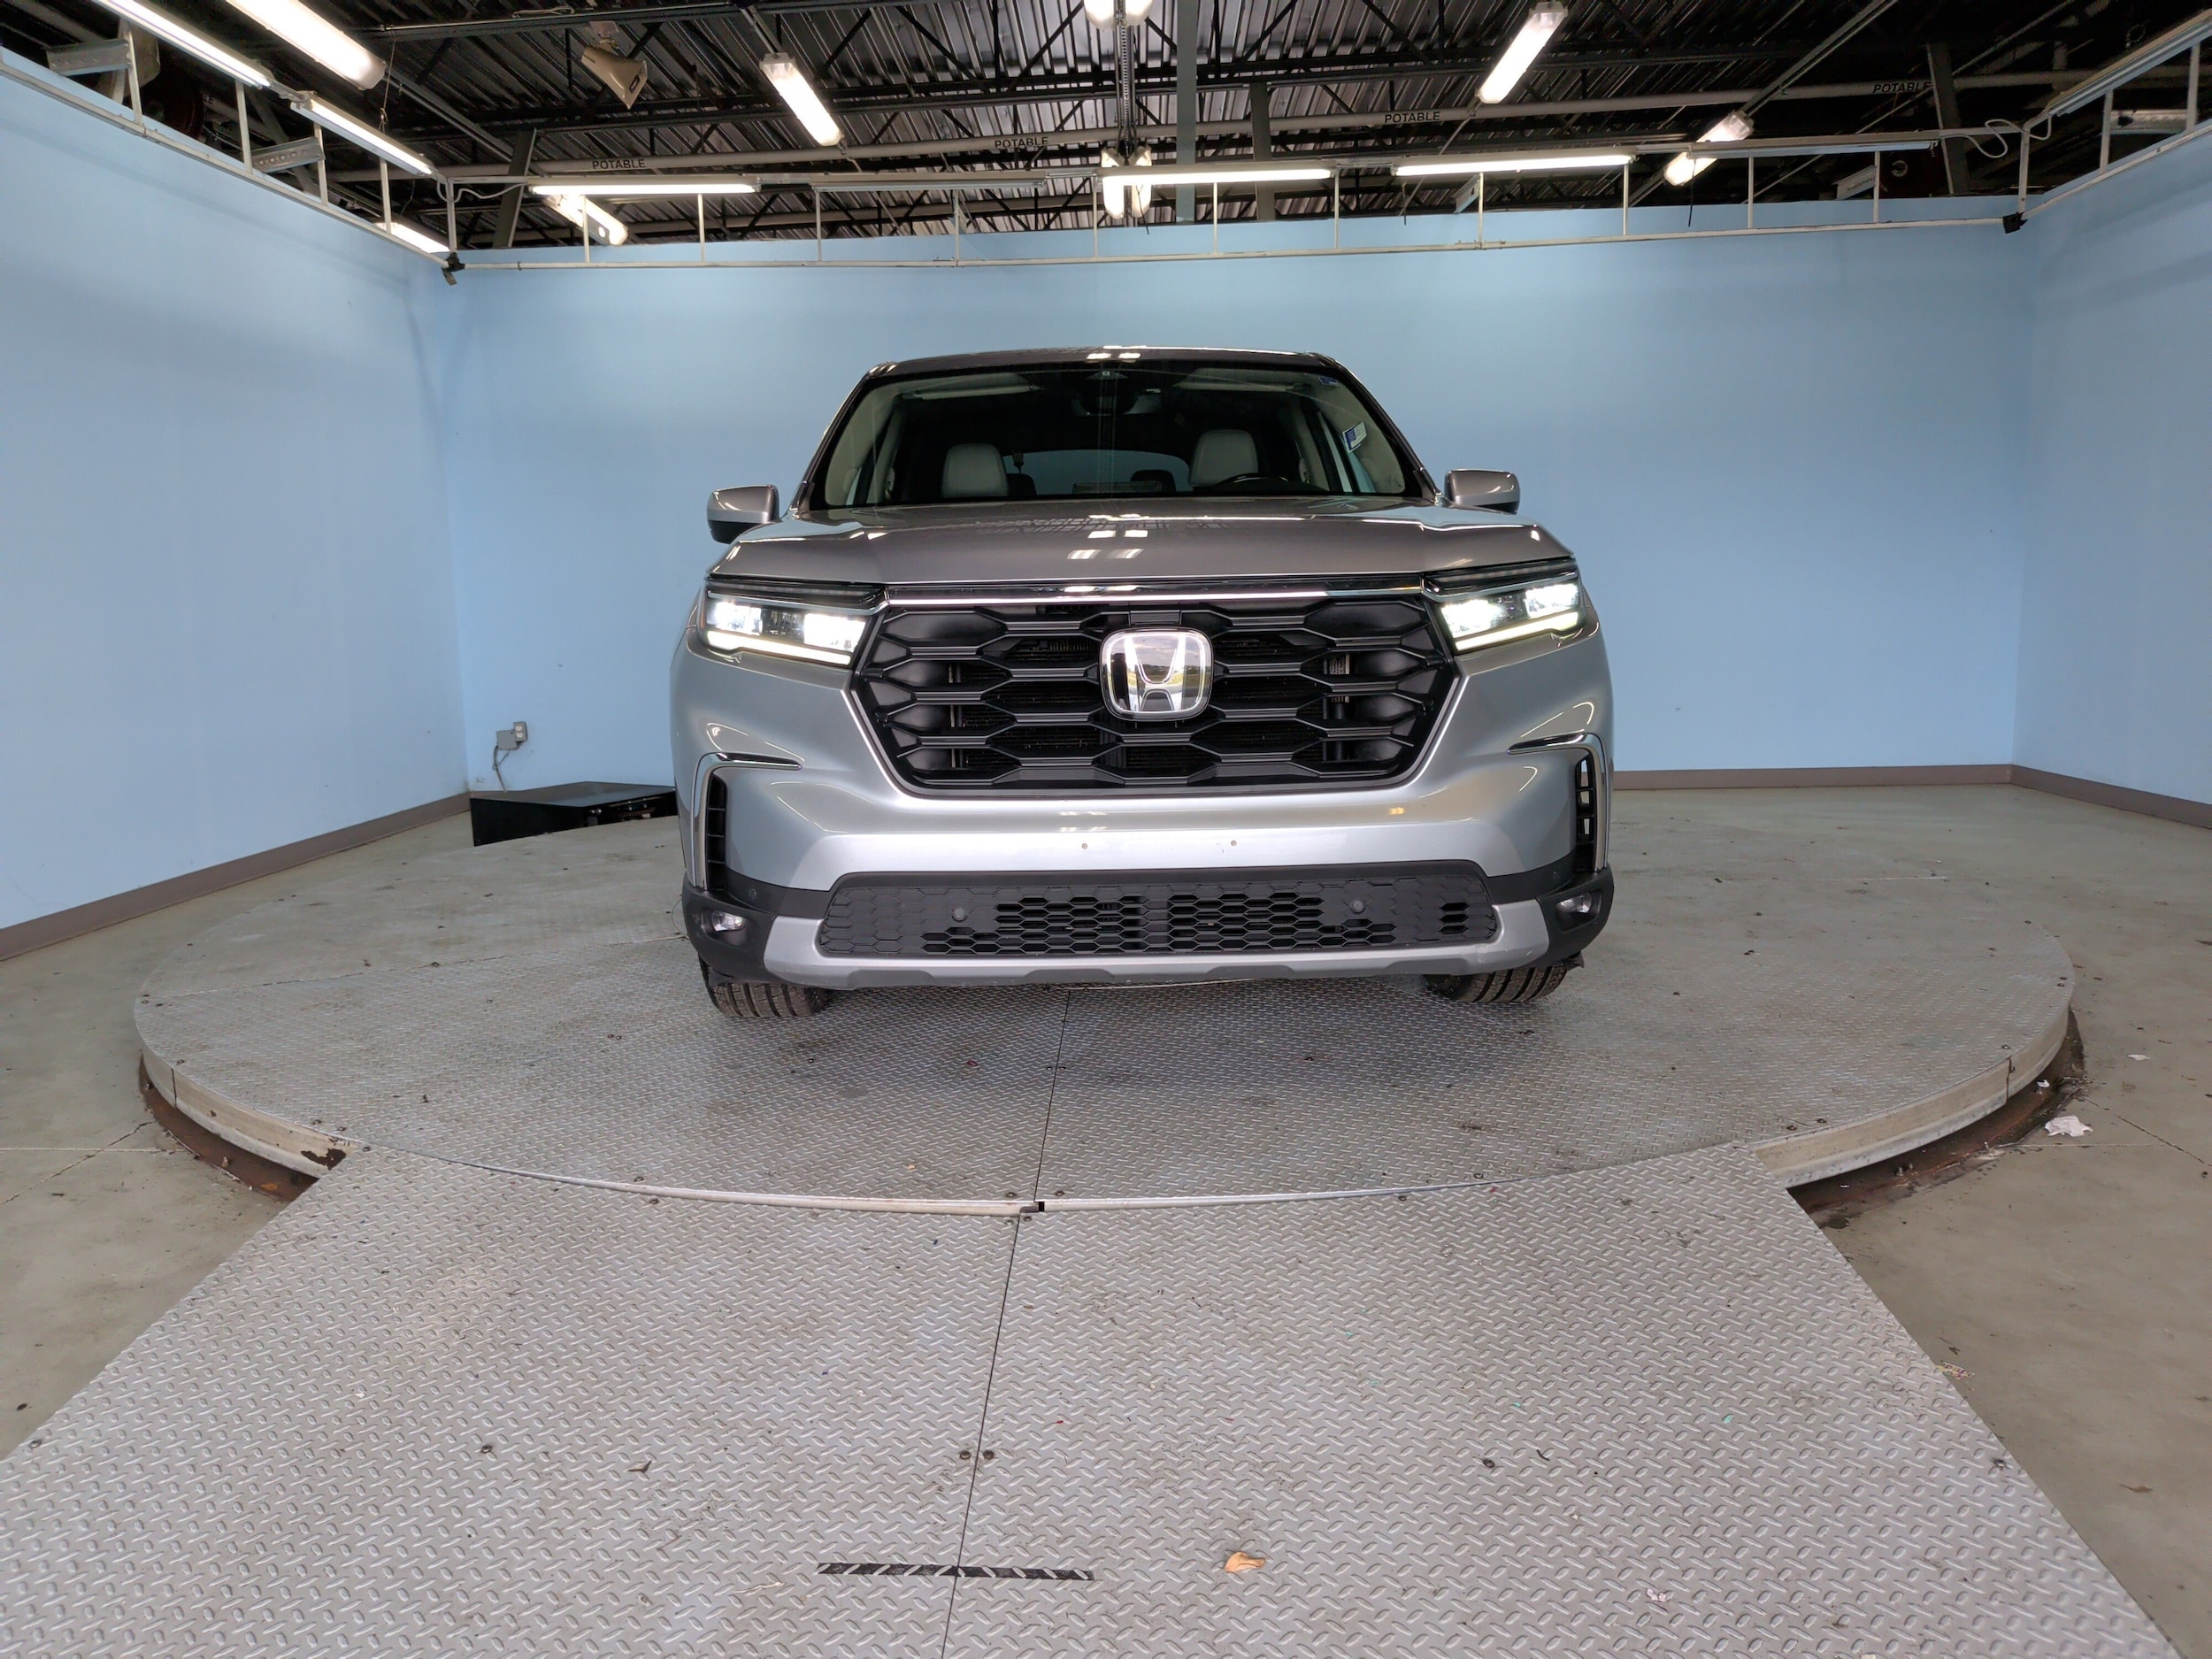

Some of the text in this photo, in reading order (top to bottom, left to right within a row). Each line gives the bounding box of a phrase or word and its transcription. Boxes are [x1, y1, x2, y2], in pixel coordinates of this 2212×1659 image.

[1384, 111, 1440, 123] POTABLE
[995, 136, 1048, 148] POTABLE
[592, 158, 646, 170] POTABLE
